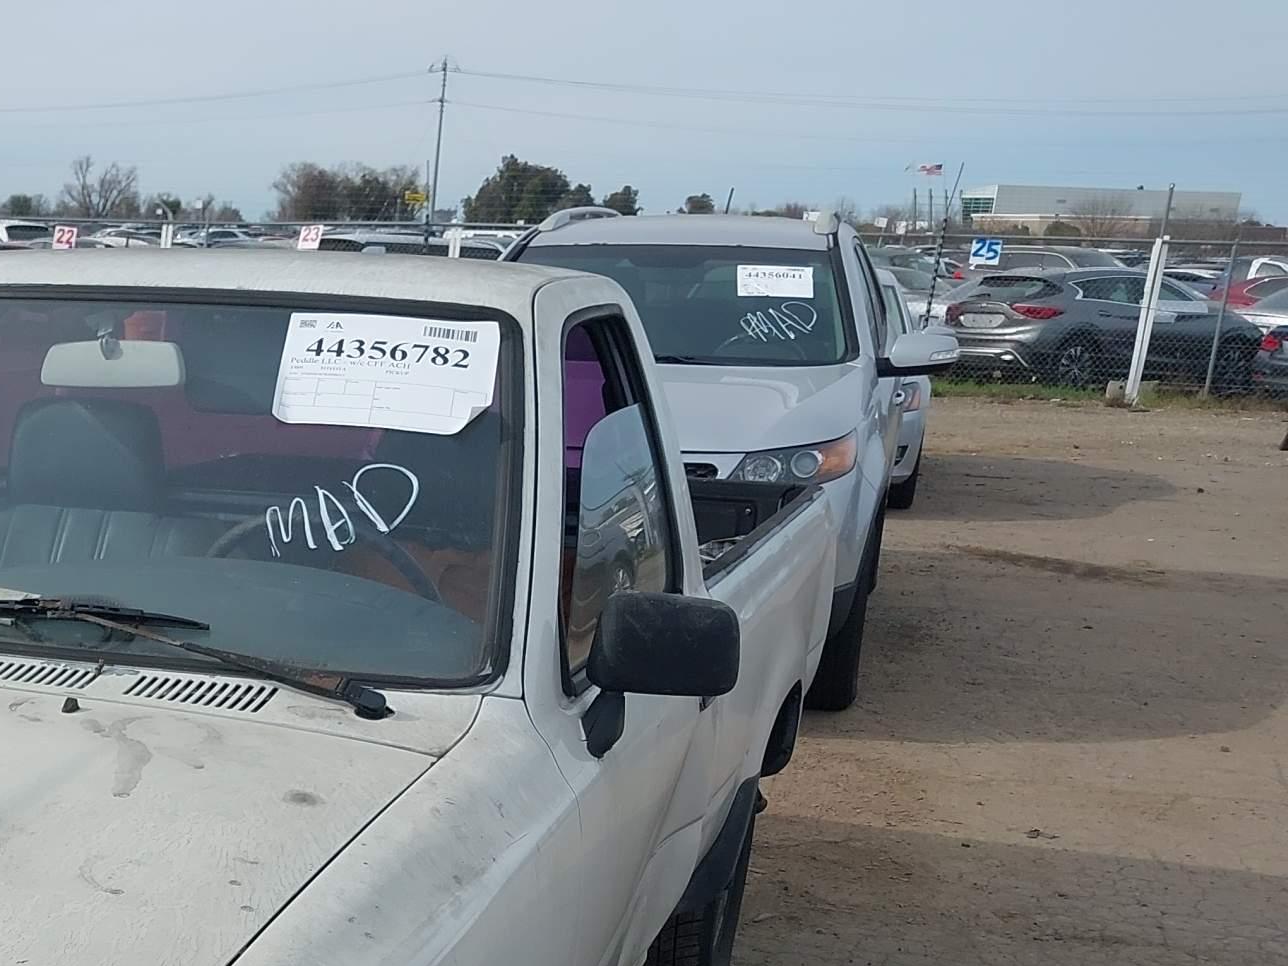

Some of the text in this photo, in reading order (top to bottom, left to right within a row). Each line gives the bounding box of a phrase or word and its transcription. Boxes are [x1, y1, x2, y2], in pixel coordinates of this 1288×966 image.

[55, 228, 75, 245] 22
[301, 226, 321, 242] 23
[972, 239, 1001, 260] 25
[305, 337, 470, 369] 44356782
[266, 463, 420, 557] MAD
